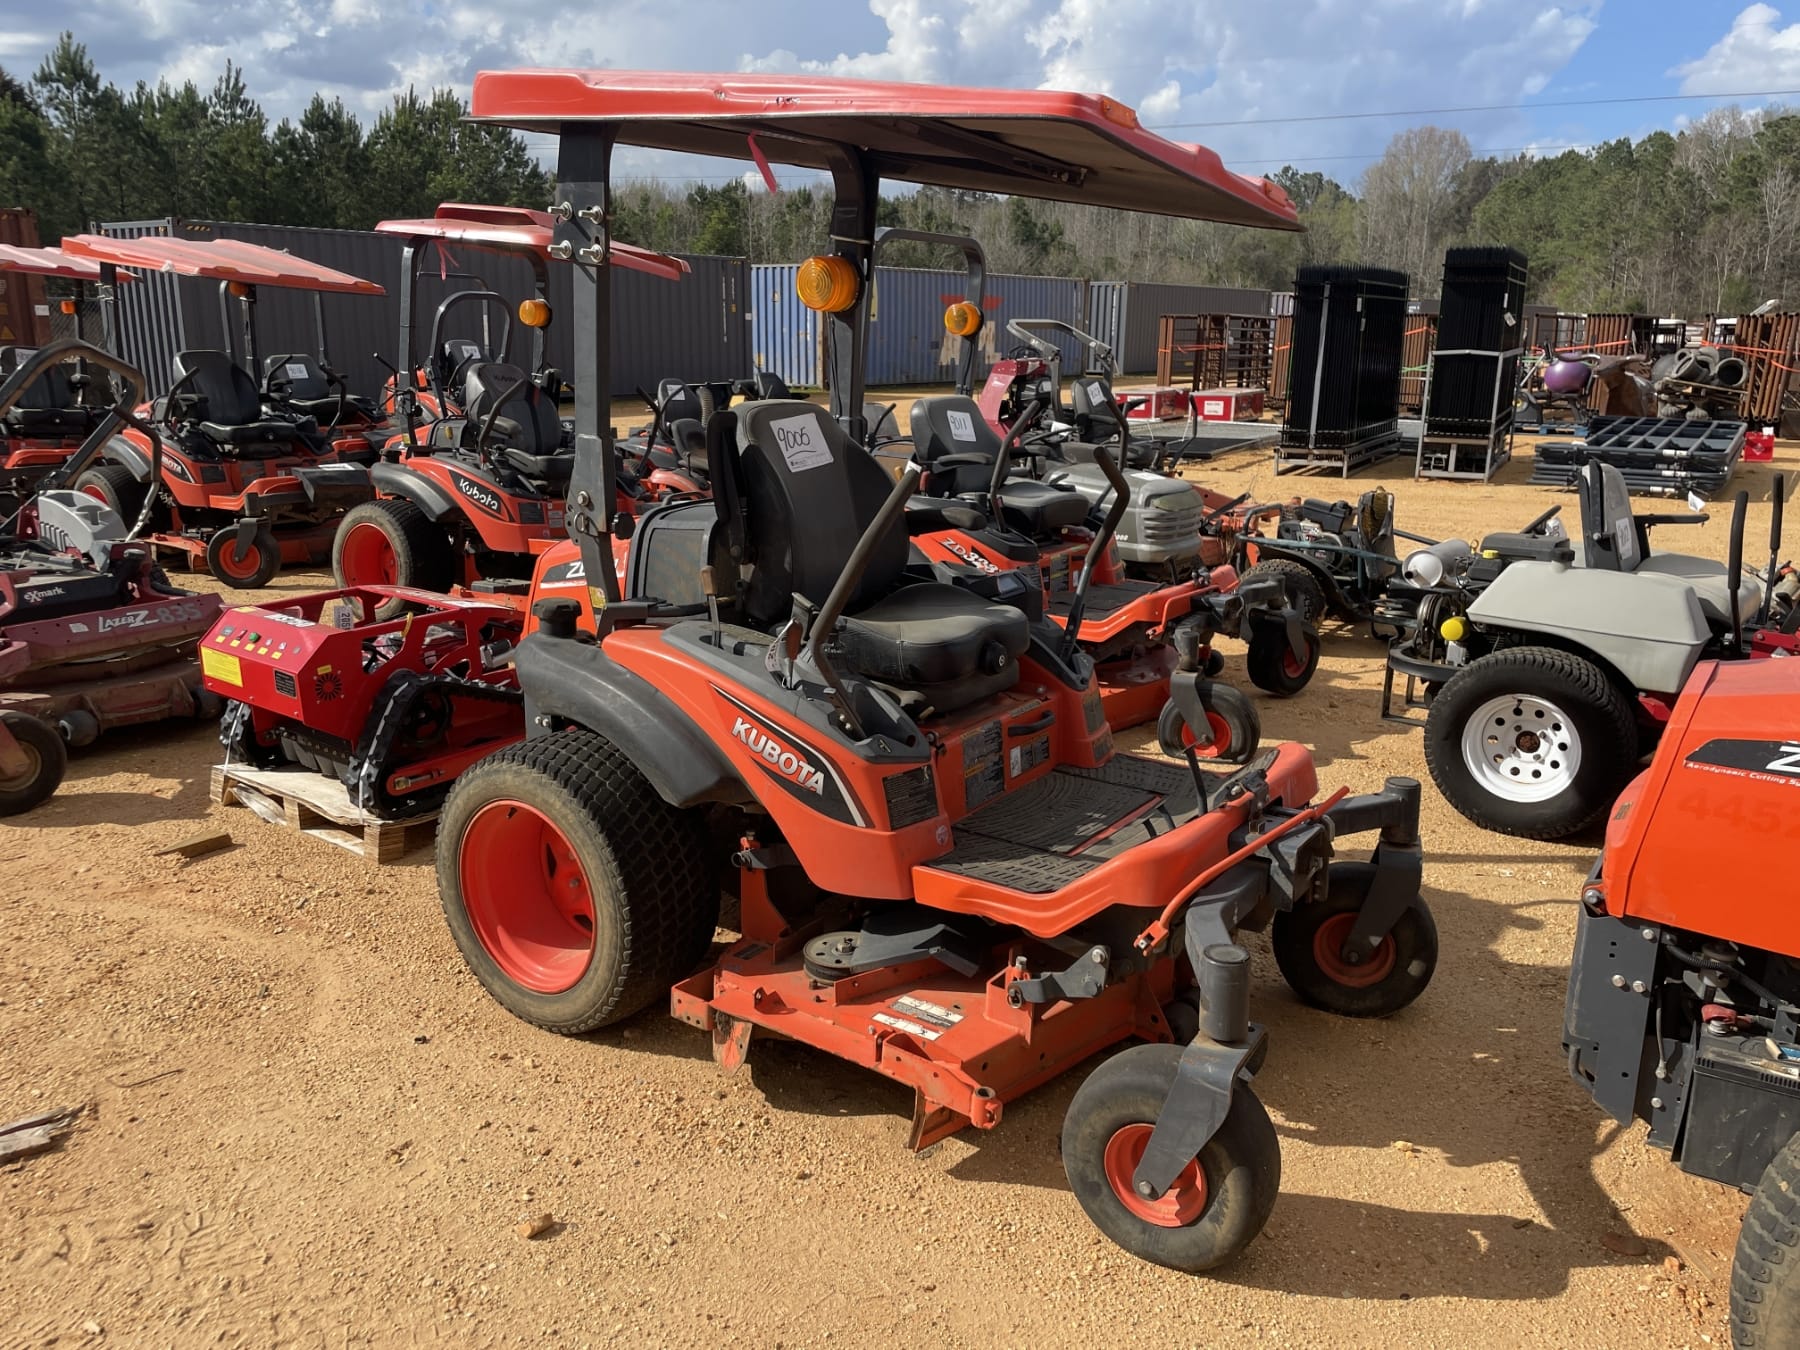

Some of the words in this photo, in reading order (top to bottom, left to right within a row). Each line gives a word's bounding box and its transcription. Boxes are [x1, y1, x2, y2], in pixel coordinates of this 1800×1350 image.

[459, 478, 499, 510] Kubota
[731, 717, 825, 796] KUBOTA
[1687, 762, 1747, 777] Aerodynamic
[1749, 772, 1786, 784] Cutting
